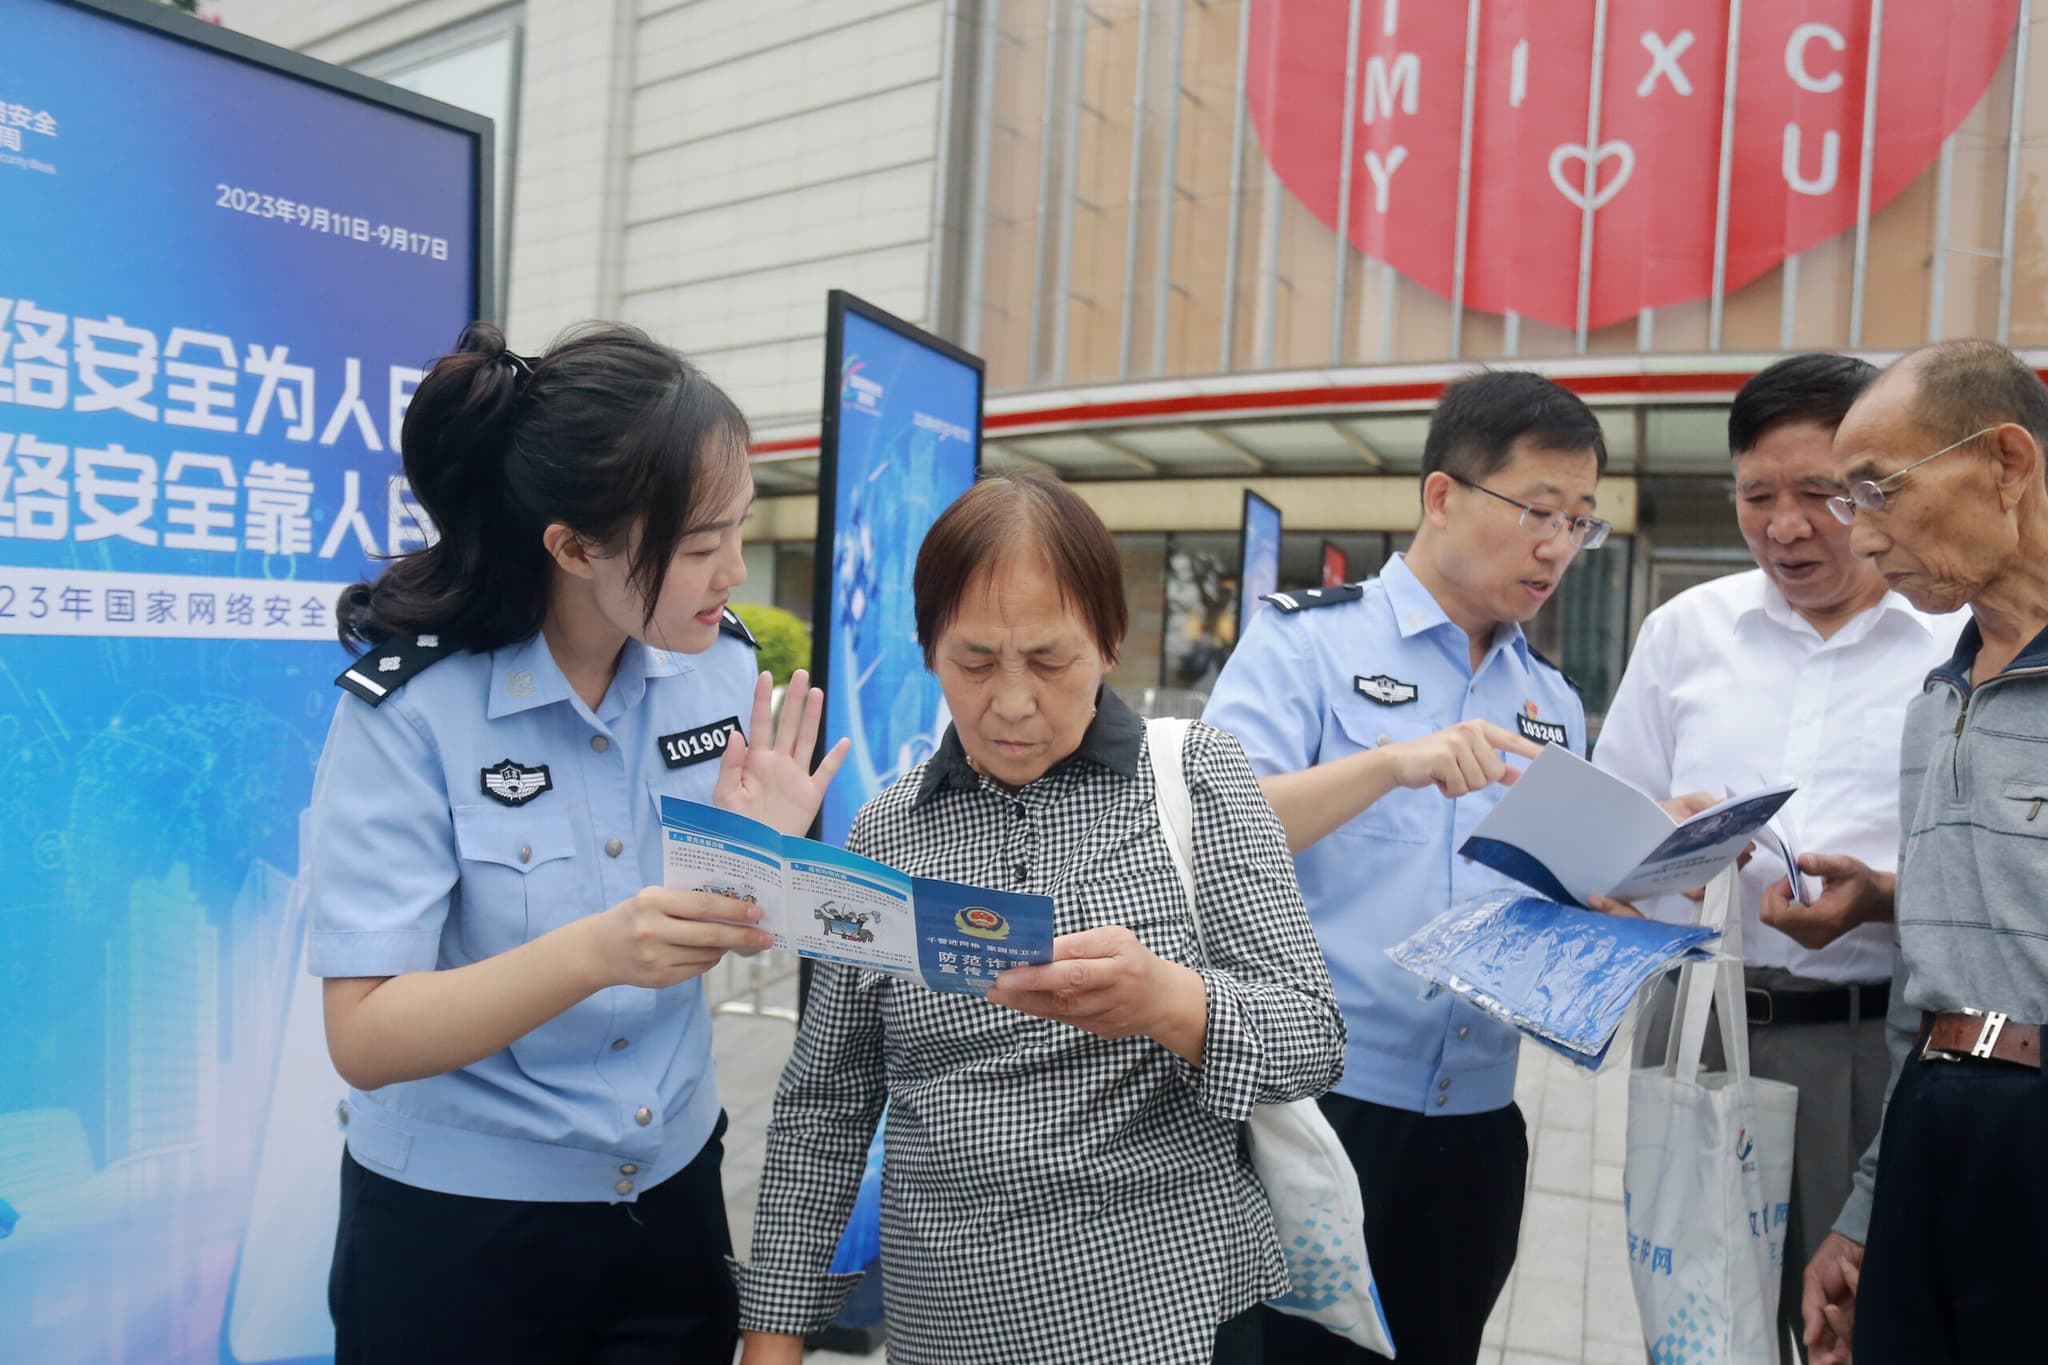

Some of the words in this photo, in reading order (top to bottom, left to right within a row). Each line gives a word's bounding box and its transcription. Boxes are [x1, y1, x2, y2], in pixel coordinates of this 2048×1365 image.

[215, 184, 449, 261] 2023年9月11日-9月17日
[0, 585, 327, 628] 23年国家网络安全
